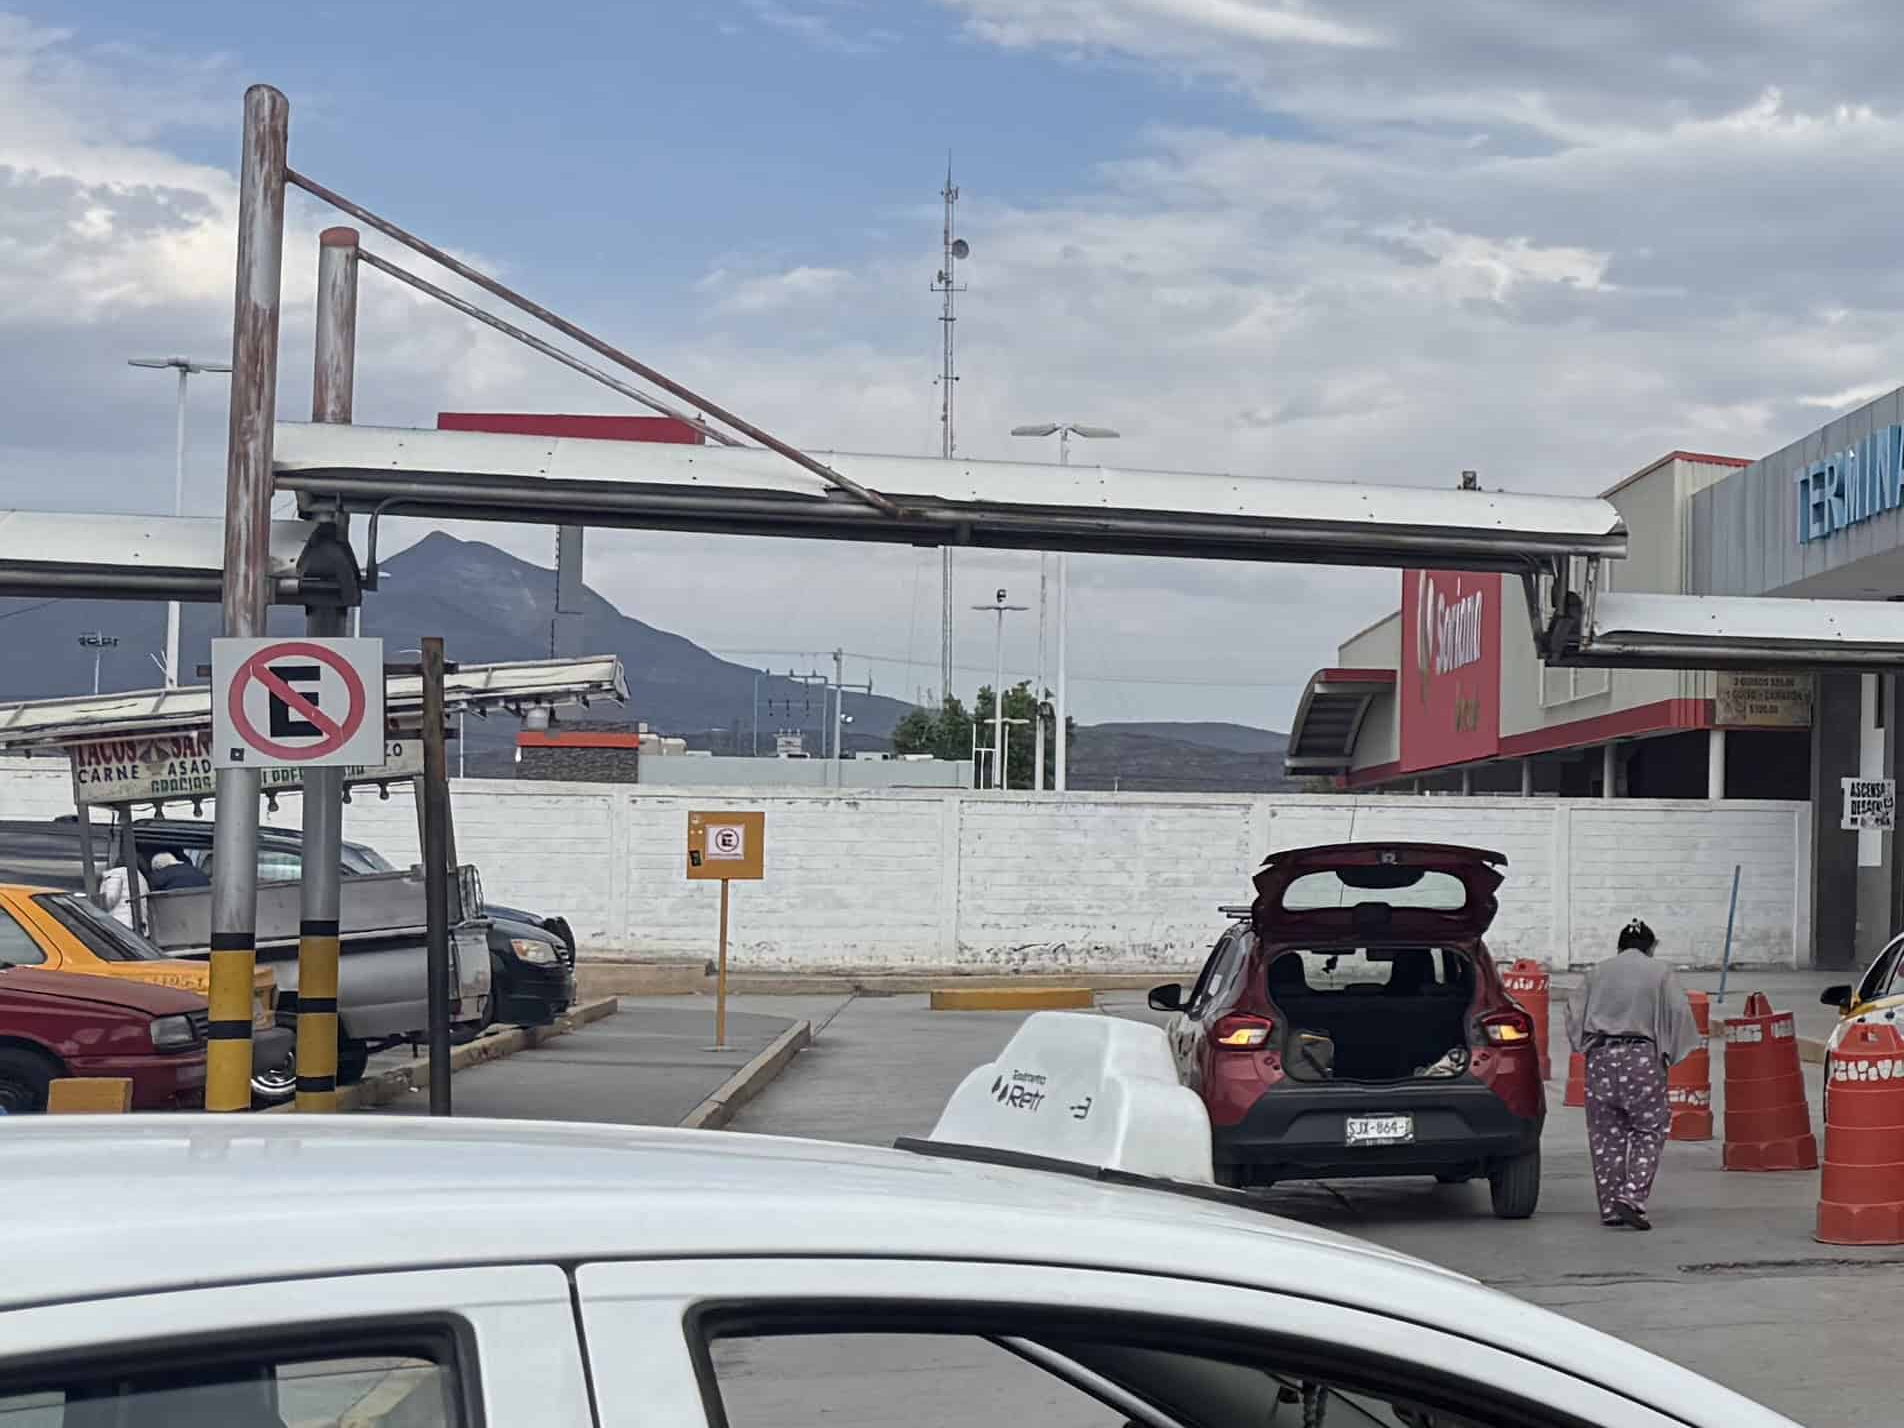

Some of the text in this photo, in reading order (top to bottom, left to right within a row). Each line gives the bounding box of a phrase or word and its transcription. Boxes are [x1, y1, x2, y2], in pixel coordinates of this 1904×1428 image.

[1436, 575, 1482, 675] Soriana
[78, 740, 137, 767] TACOS
[79, 759, 212, 784] CARNE ASAD
[1850, 782, 1886, 798] ASCENS
